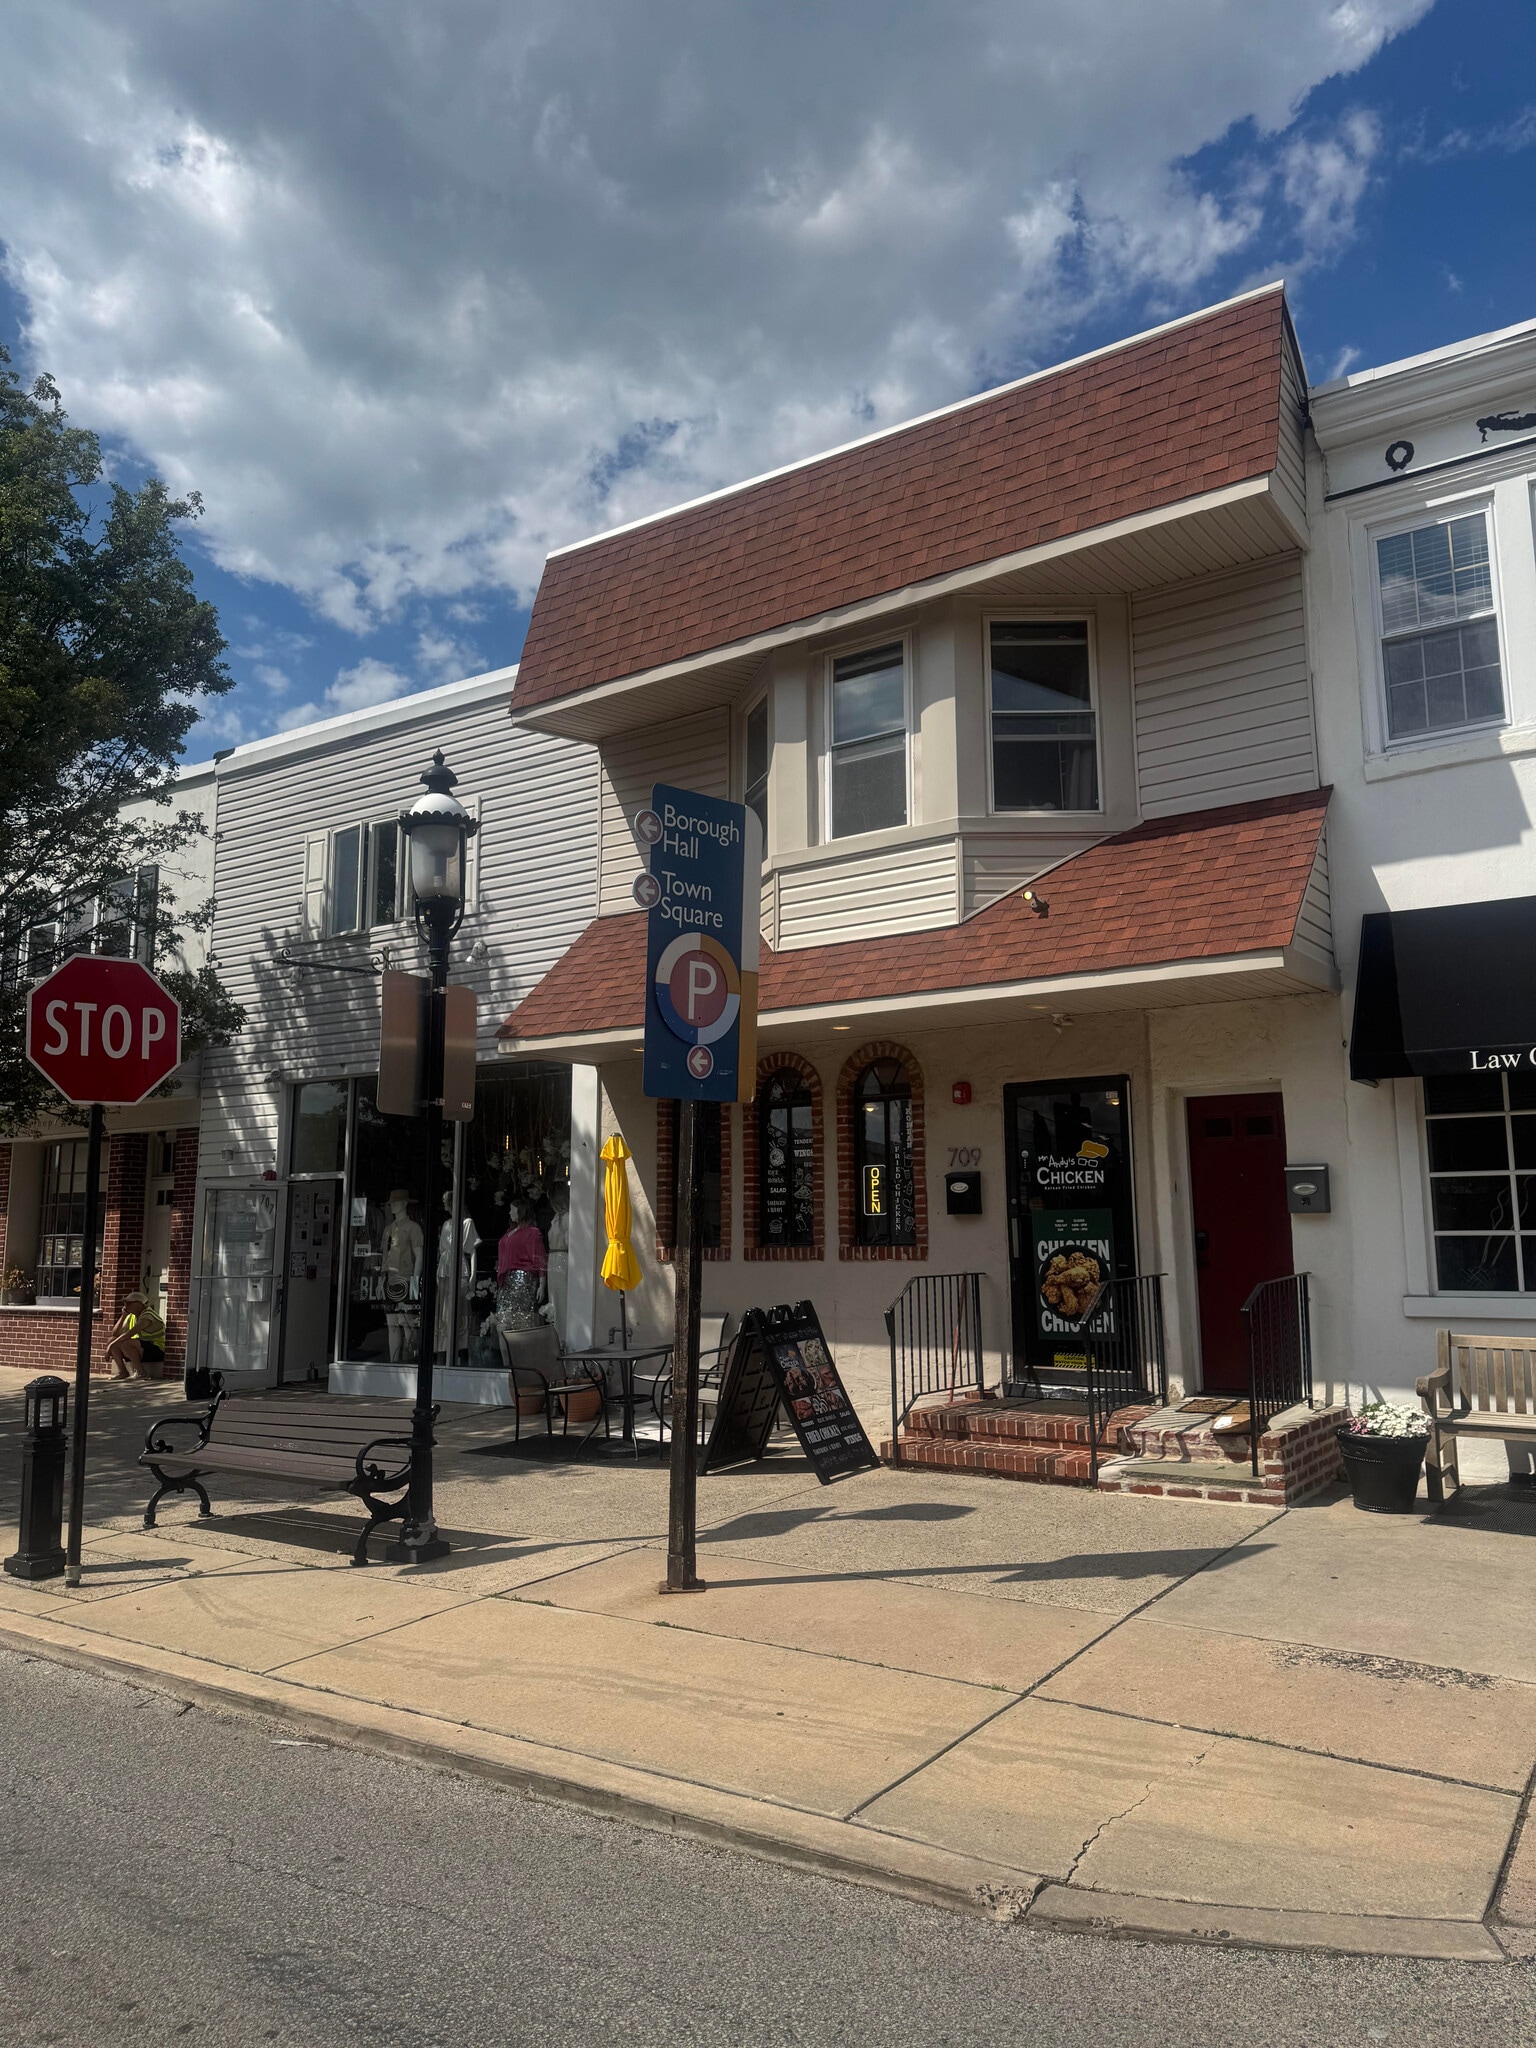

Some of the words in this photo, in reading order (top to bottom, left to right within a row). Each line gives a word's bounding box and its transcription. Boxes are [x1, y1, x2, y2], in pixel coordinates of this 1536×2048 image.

[664, 804, 740, 846] Borough
[663, 830, 699, 860] Hall
[661, 870, 712, 902] Town
[660, 896, 723, 928] Square
[688, 960, 717, 1020] P
[43, 999, 166, 1060] STOP
[1469, 1050, 1522, 1070] Law
[947, 1147, 982, 1167] 709
[1048, 1154, 1076, 1169] Andy's
[1036, 1166, 1105, 1185] CHICKEN
[870, 1167, 881, 1213] OPEN
[260, 1194, 275, 1216] 707
[1037, 1239, 1110, 1262] CHEN
[839, 1410, 851, 1418] SALAD
[804, 1428, 822, 1445] FRIED
[818, 1423, 842, 1441] CHICKEN
[843, 1432, 863, 1446] WINGS
